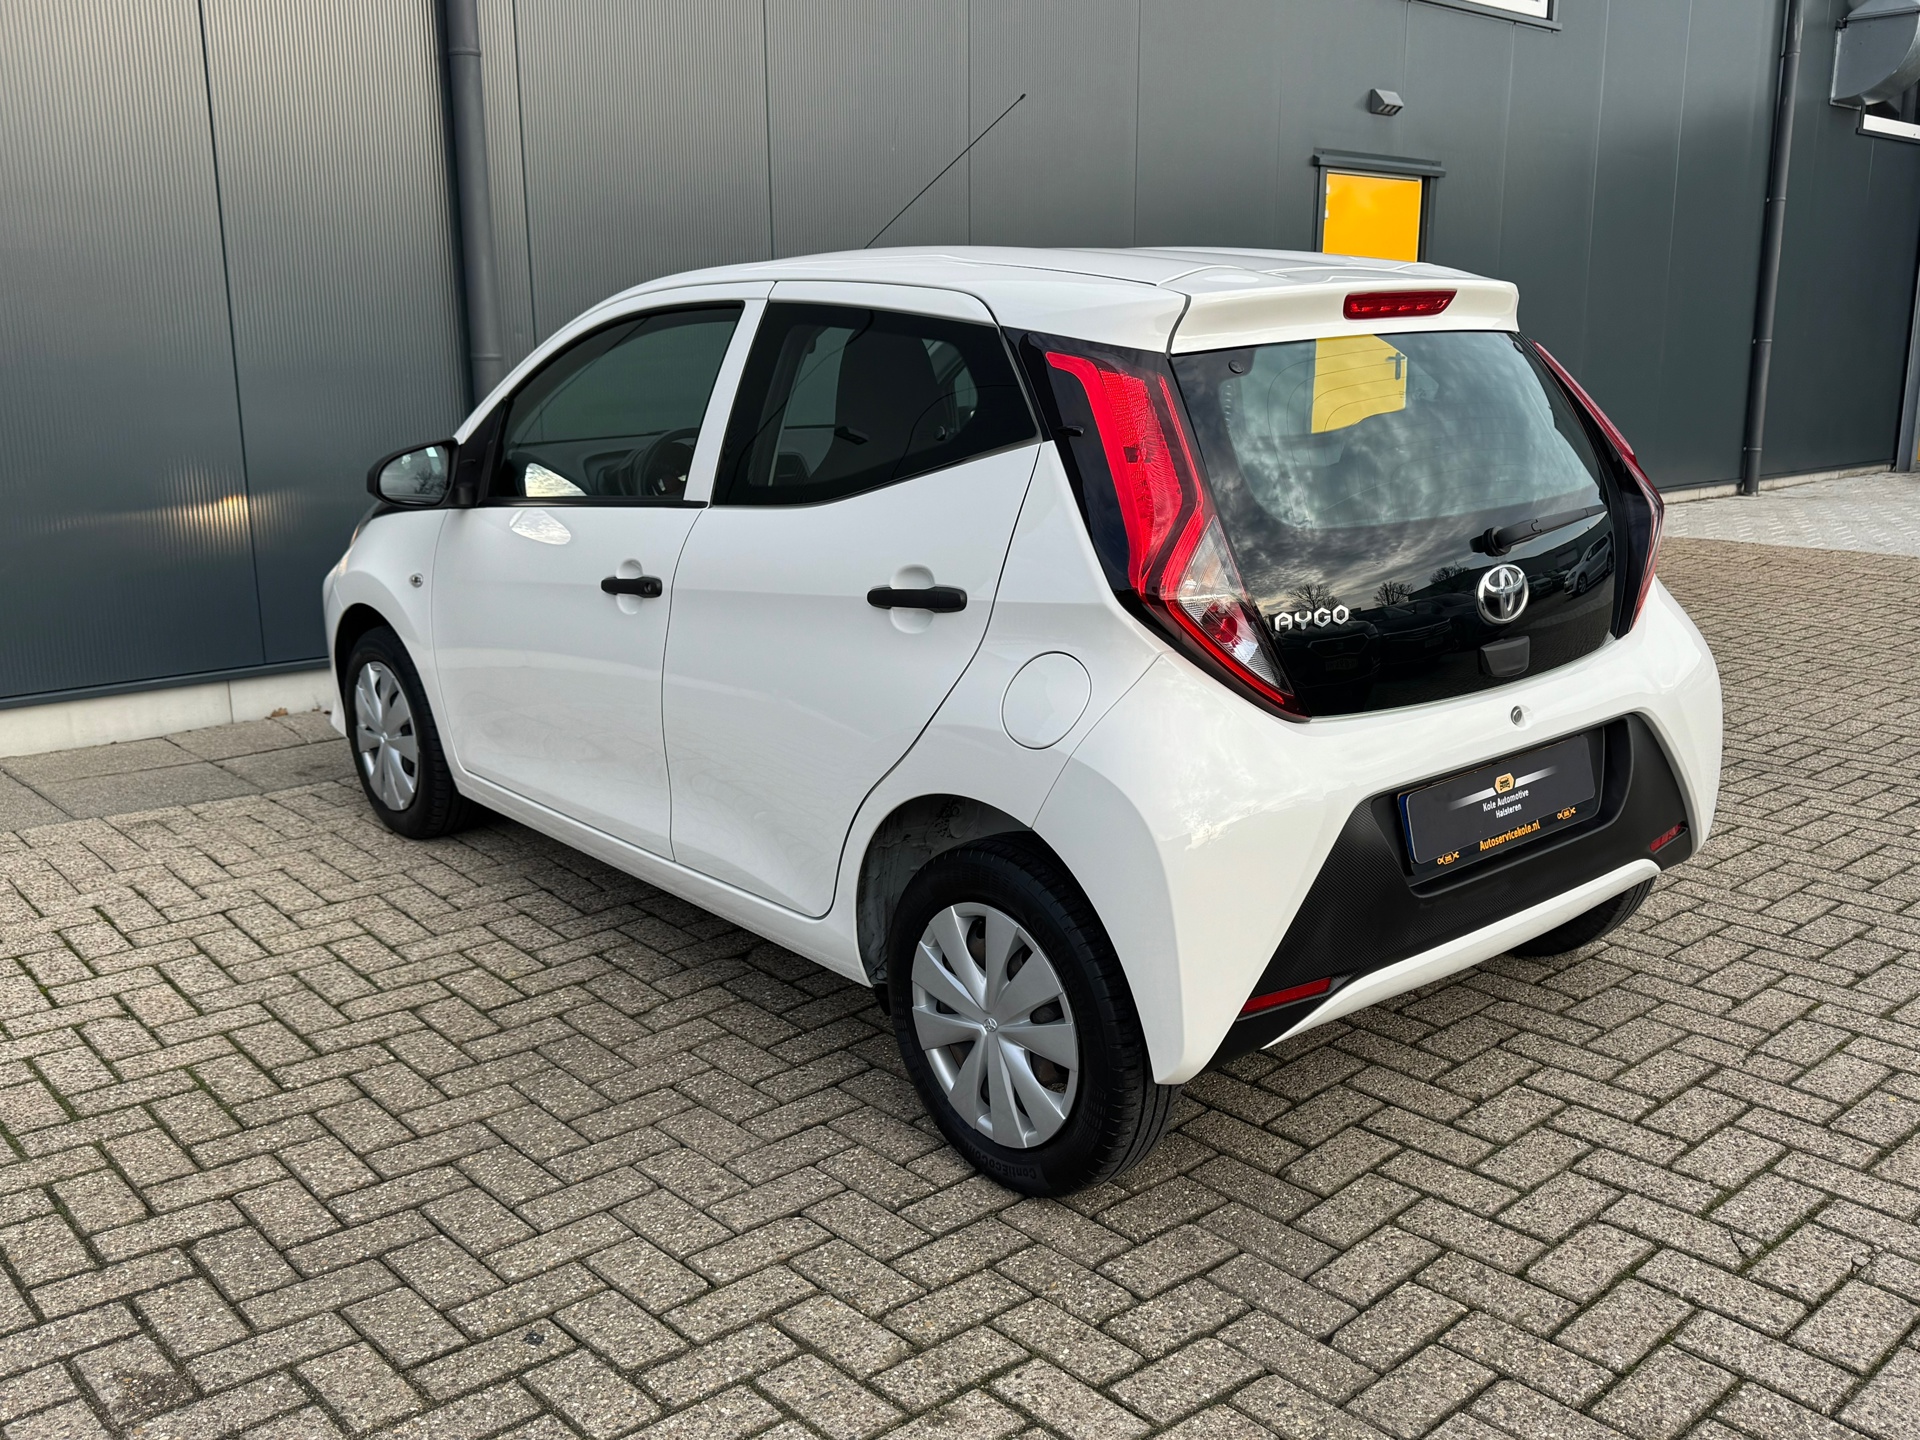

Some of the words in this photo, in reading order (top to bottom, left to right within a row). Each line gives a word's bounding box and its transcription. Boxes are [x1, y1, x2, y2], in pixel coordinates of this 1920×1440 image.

[1274, 604, 1350, 632] AYGO
[1482, 800, 1496, 812] Kole
[1497, 789, 1529, 807] Automotive
[1495, 803, 1522, 818] Halsteren
[1479, 819, 1540, 851] Autoservicekole.nl
